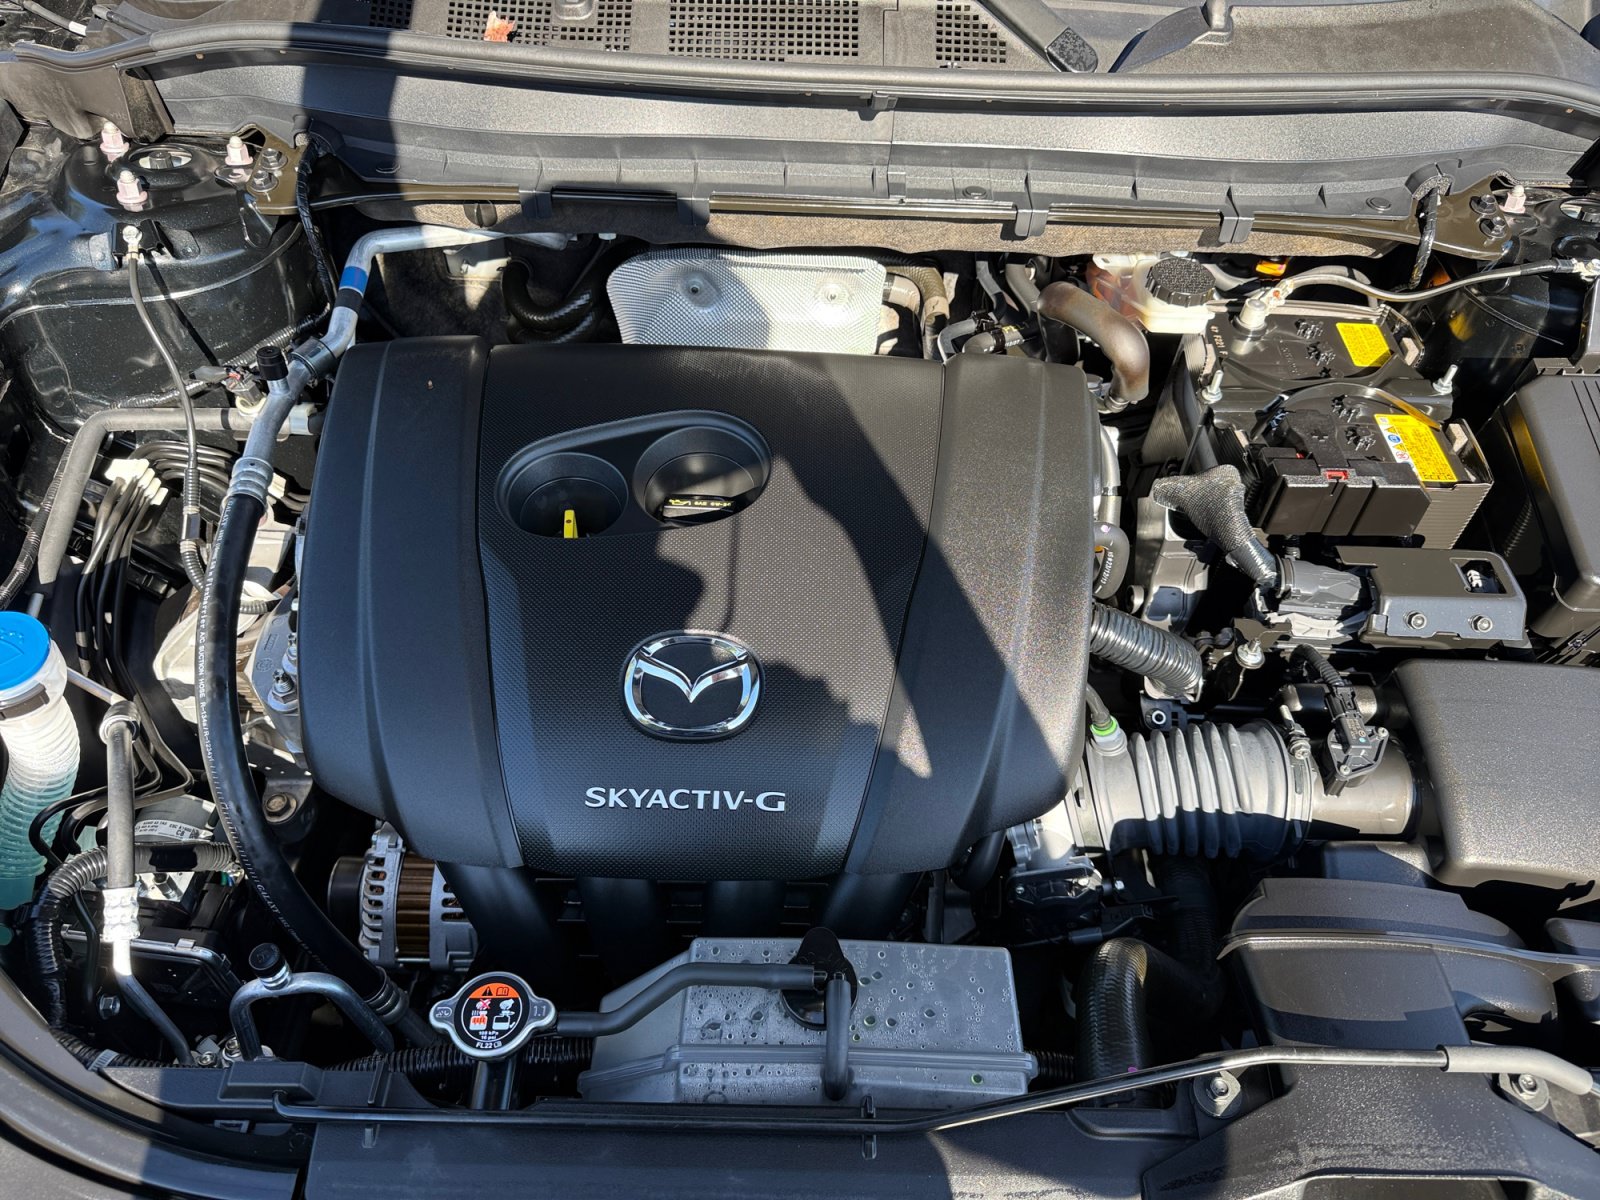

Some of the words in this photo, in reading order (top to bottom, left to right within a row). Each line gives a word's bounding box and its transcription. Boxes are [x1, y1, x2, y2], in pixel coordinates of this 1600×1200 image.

[198, 679, 206, 699] HOSE
[584, 786, 786, 812] SKYACTIV-G
[533, 1005, 546, 1017] 1.1
